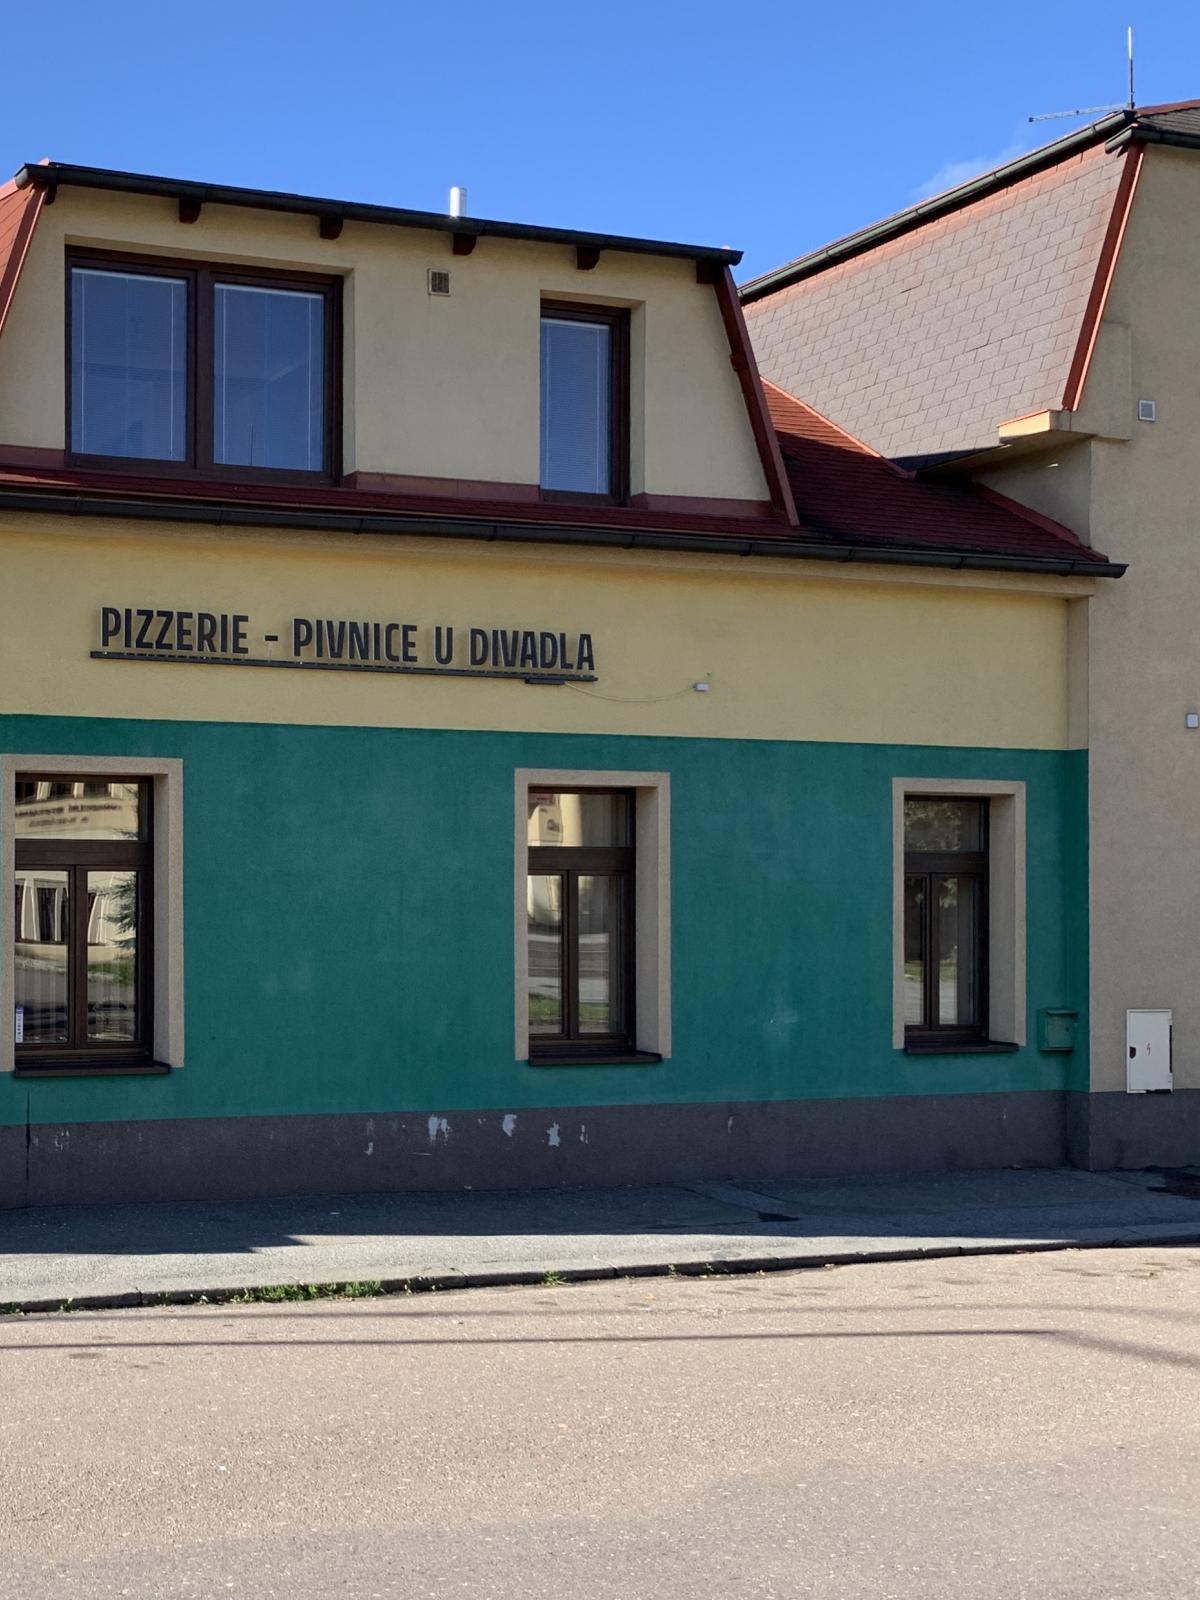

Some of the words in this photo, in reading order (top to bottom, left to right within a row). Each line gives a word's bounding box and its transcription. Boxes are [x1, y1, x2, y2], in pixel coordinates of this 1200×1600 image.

[101, 606, 249, 654] PIZZERIE
[292, 618, 418, 663] PIVNICE
[434, 626, 453, 665] U
[469, 628, 595, 671] DIVADLA
